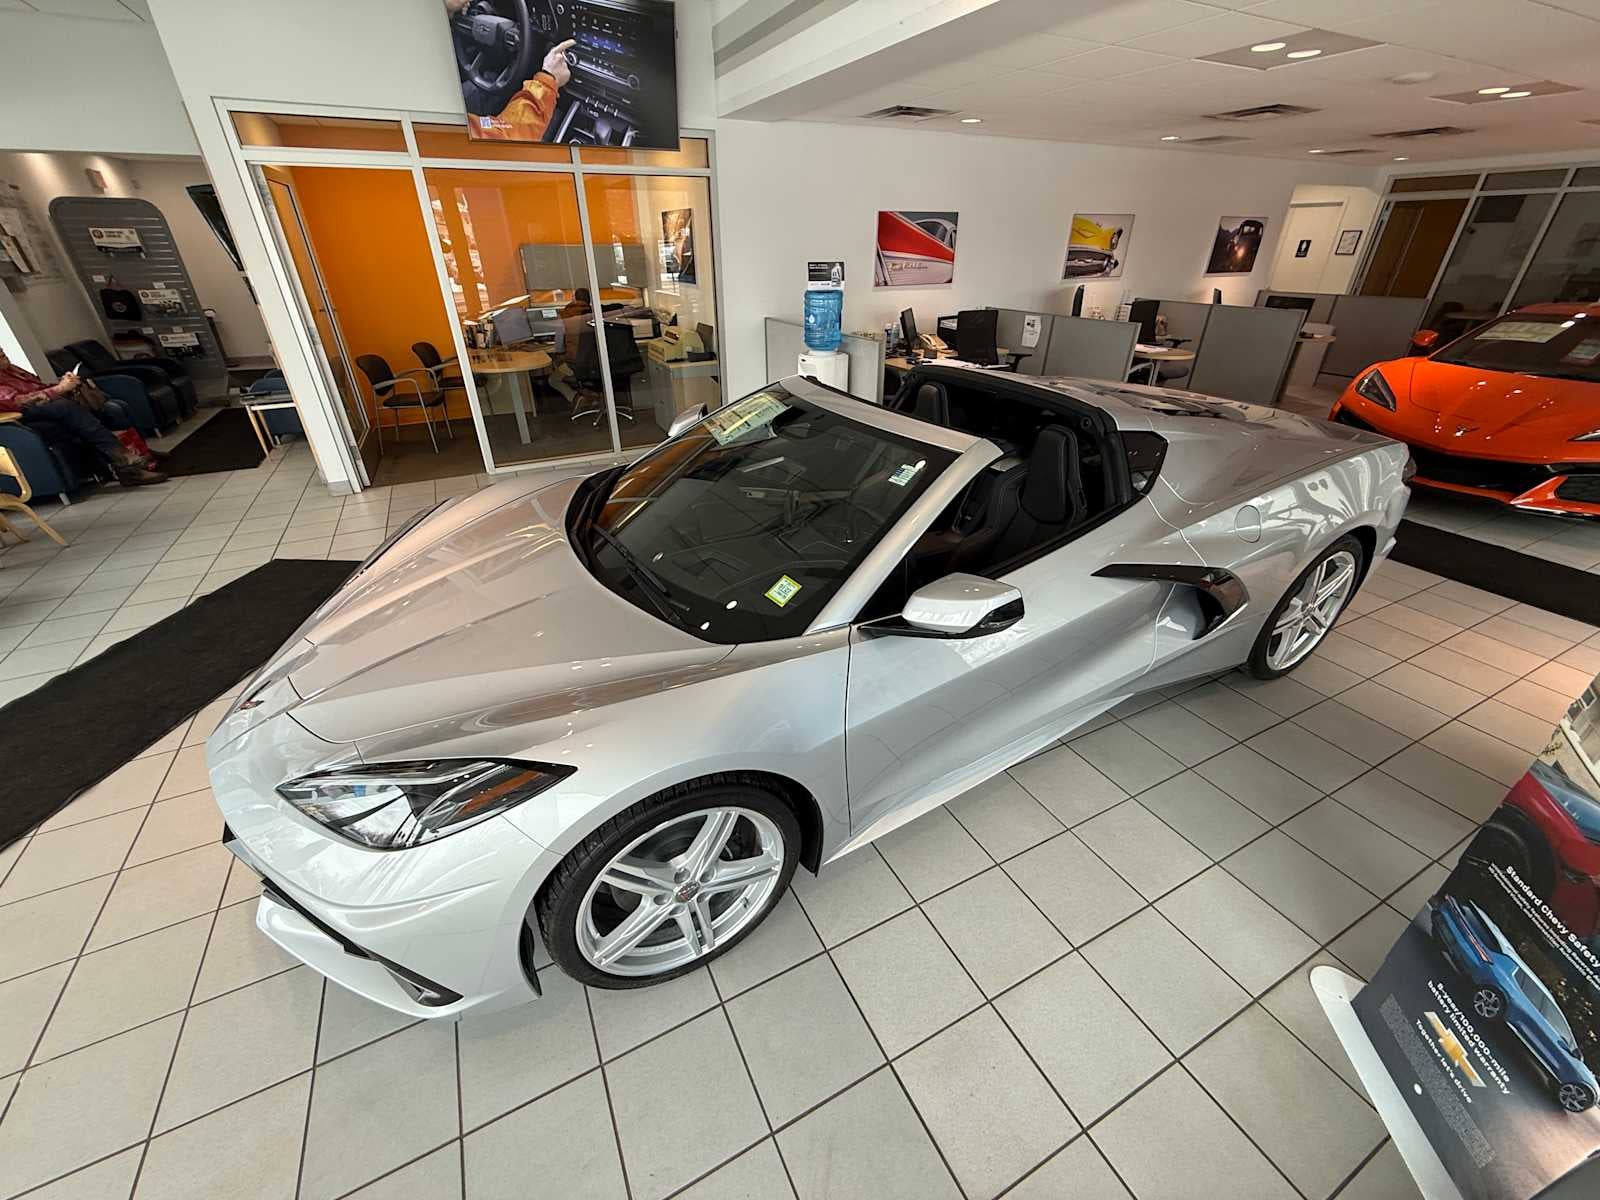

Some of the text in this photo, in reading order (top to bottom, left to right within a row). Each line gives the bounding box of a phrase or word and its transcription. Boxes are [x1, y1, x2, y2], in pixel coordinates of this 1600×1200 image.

[1506, 865, 1543, 906] Standard
[1541, 904, 1569, 934] Chevy
[1567, 932, 1600, 968] Safety
[1416, 1019, 1473, 1104] Together let's drive
[1427, 980, 1511, 1094] battery limited warranty
